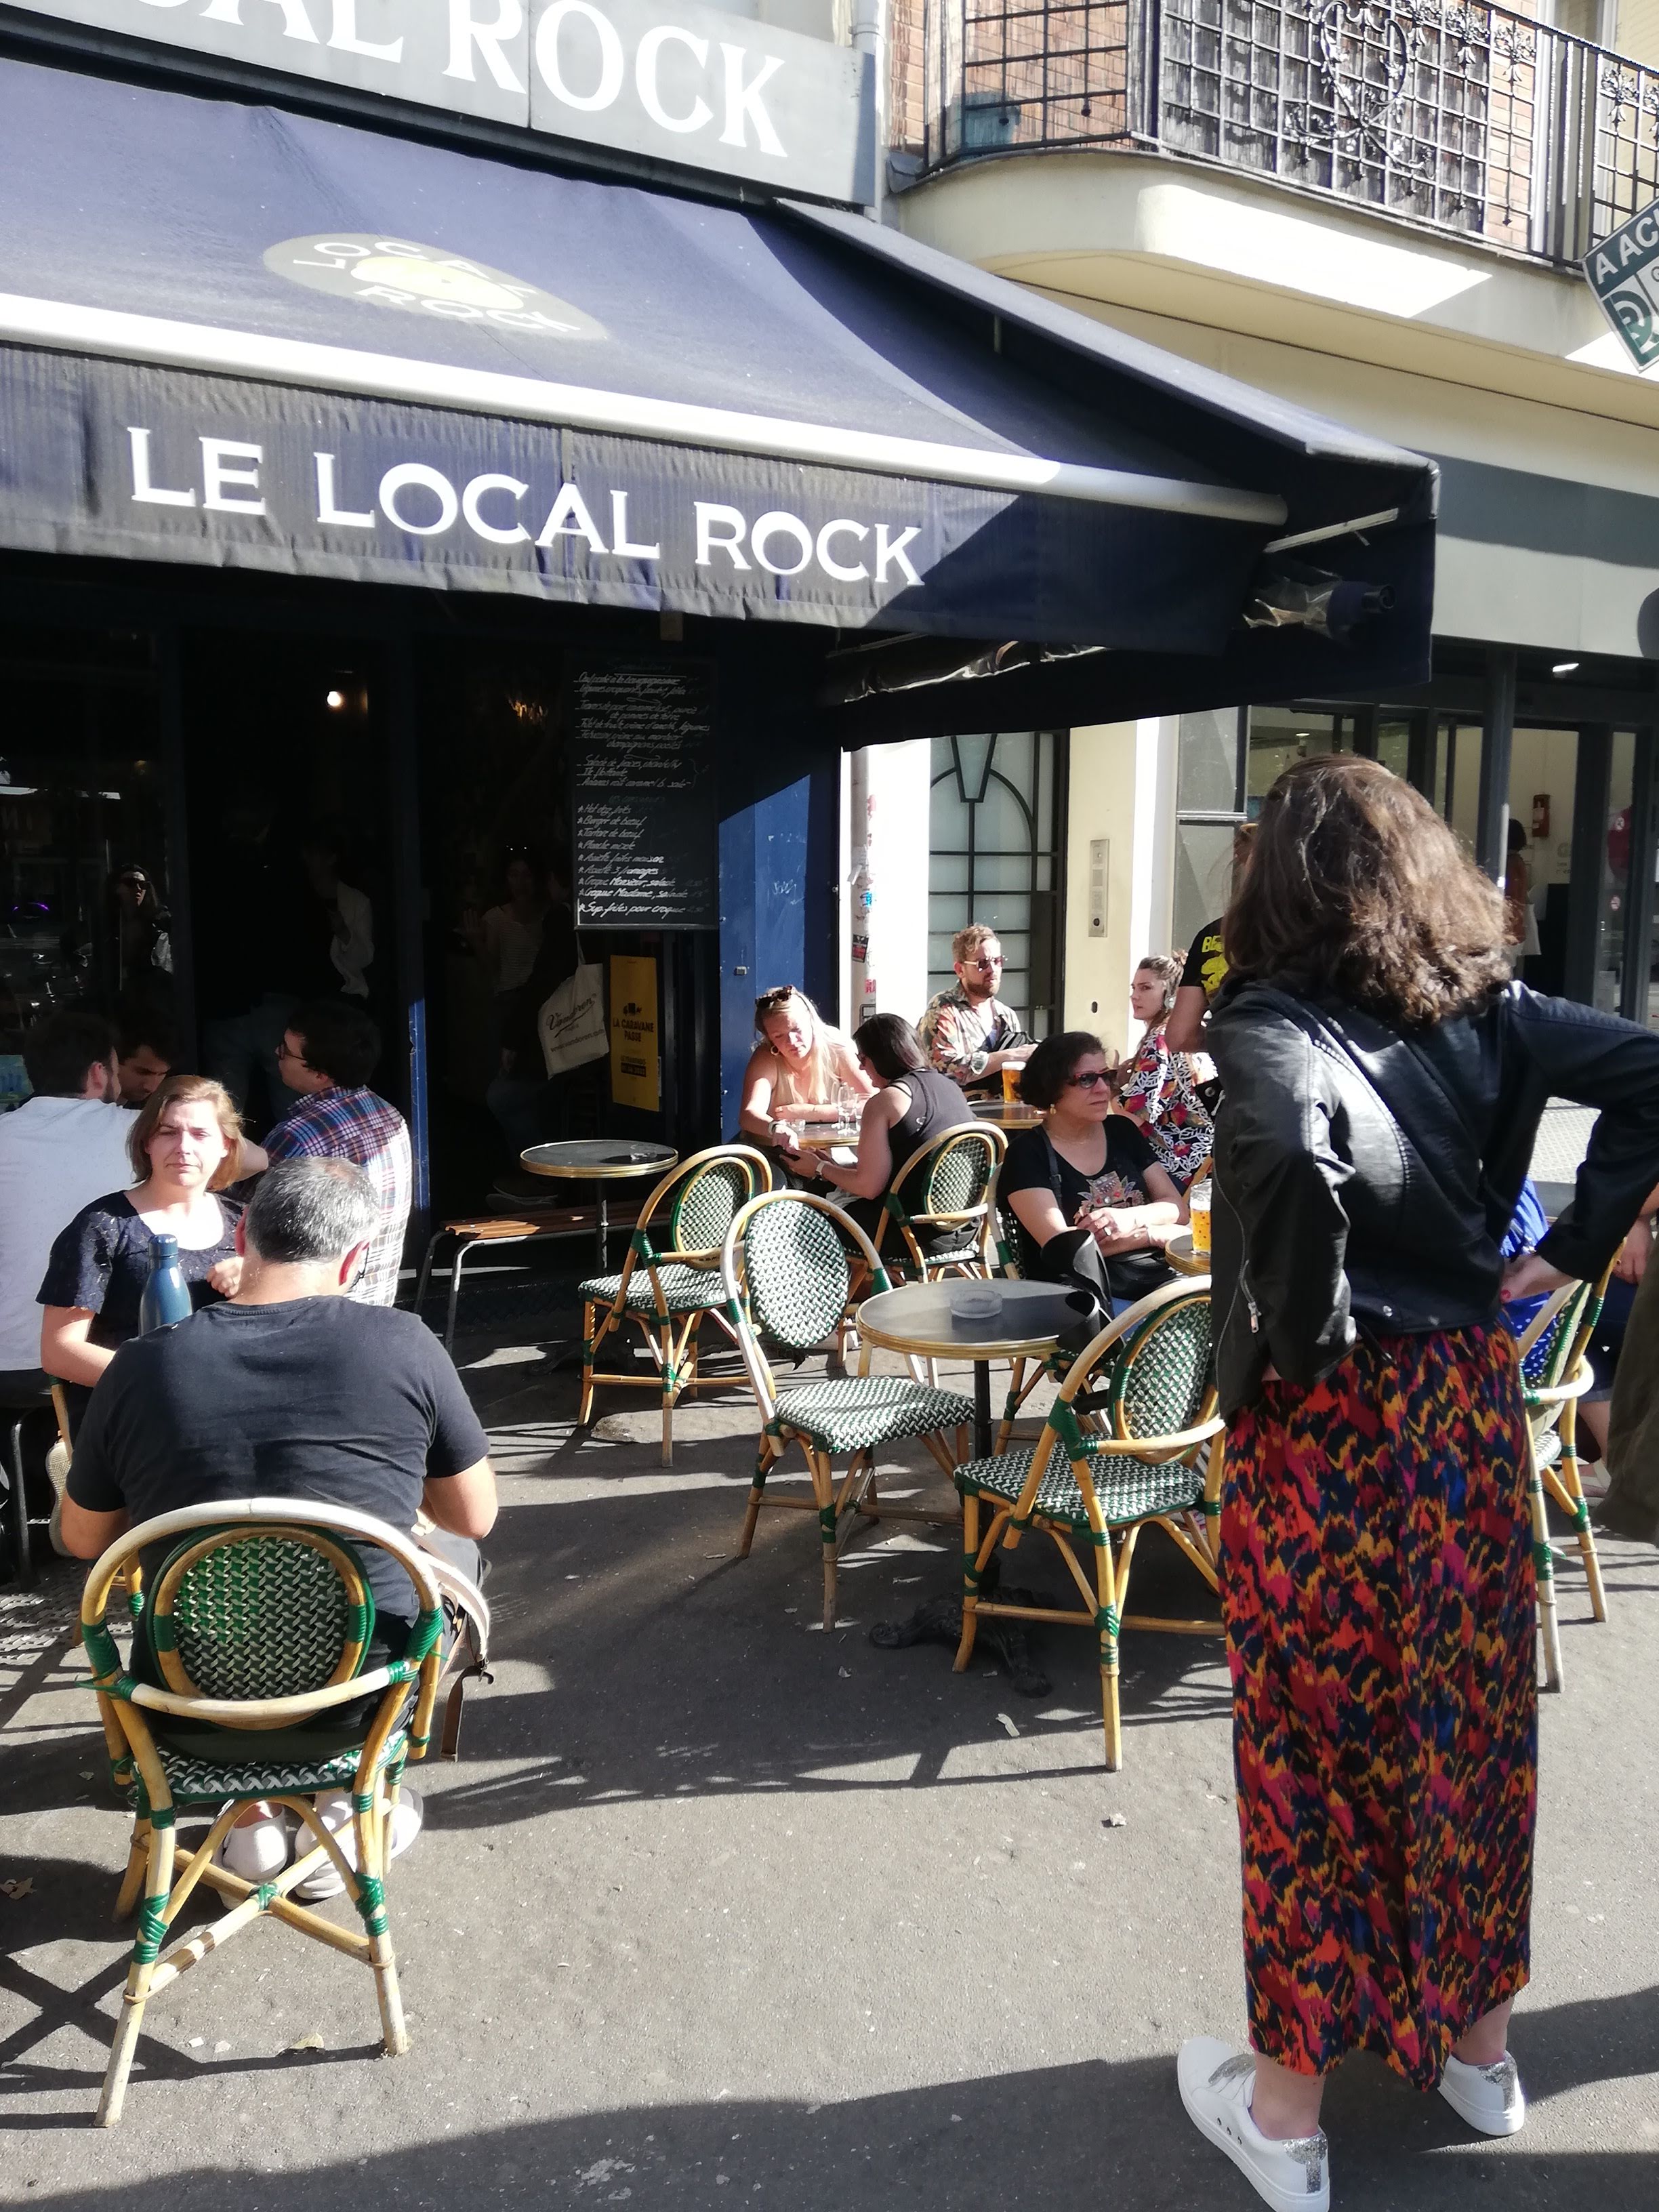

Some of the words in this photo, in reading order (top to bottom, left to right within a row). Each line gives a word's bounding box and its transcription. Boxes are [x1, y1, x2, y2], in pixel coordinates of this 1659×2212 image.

[441, 0, 787, 158] ROCK
[293, 241, 538, 297] LOCAL
[354, 285, 581, 332] ROCK
[127, 427, 266, 515] LE
[314, 453, 659, 559] LOCAL
[693, 501, 924, 586] ROCK
[625, 906, 651, 916] pour
[621, 1019, 654, 1033] CARAVANE
[624, 1030, 642, 1042] PASSE
